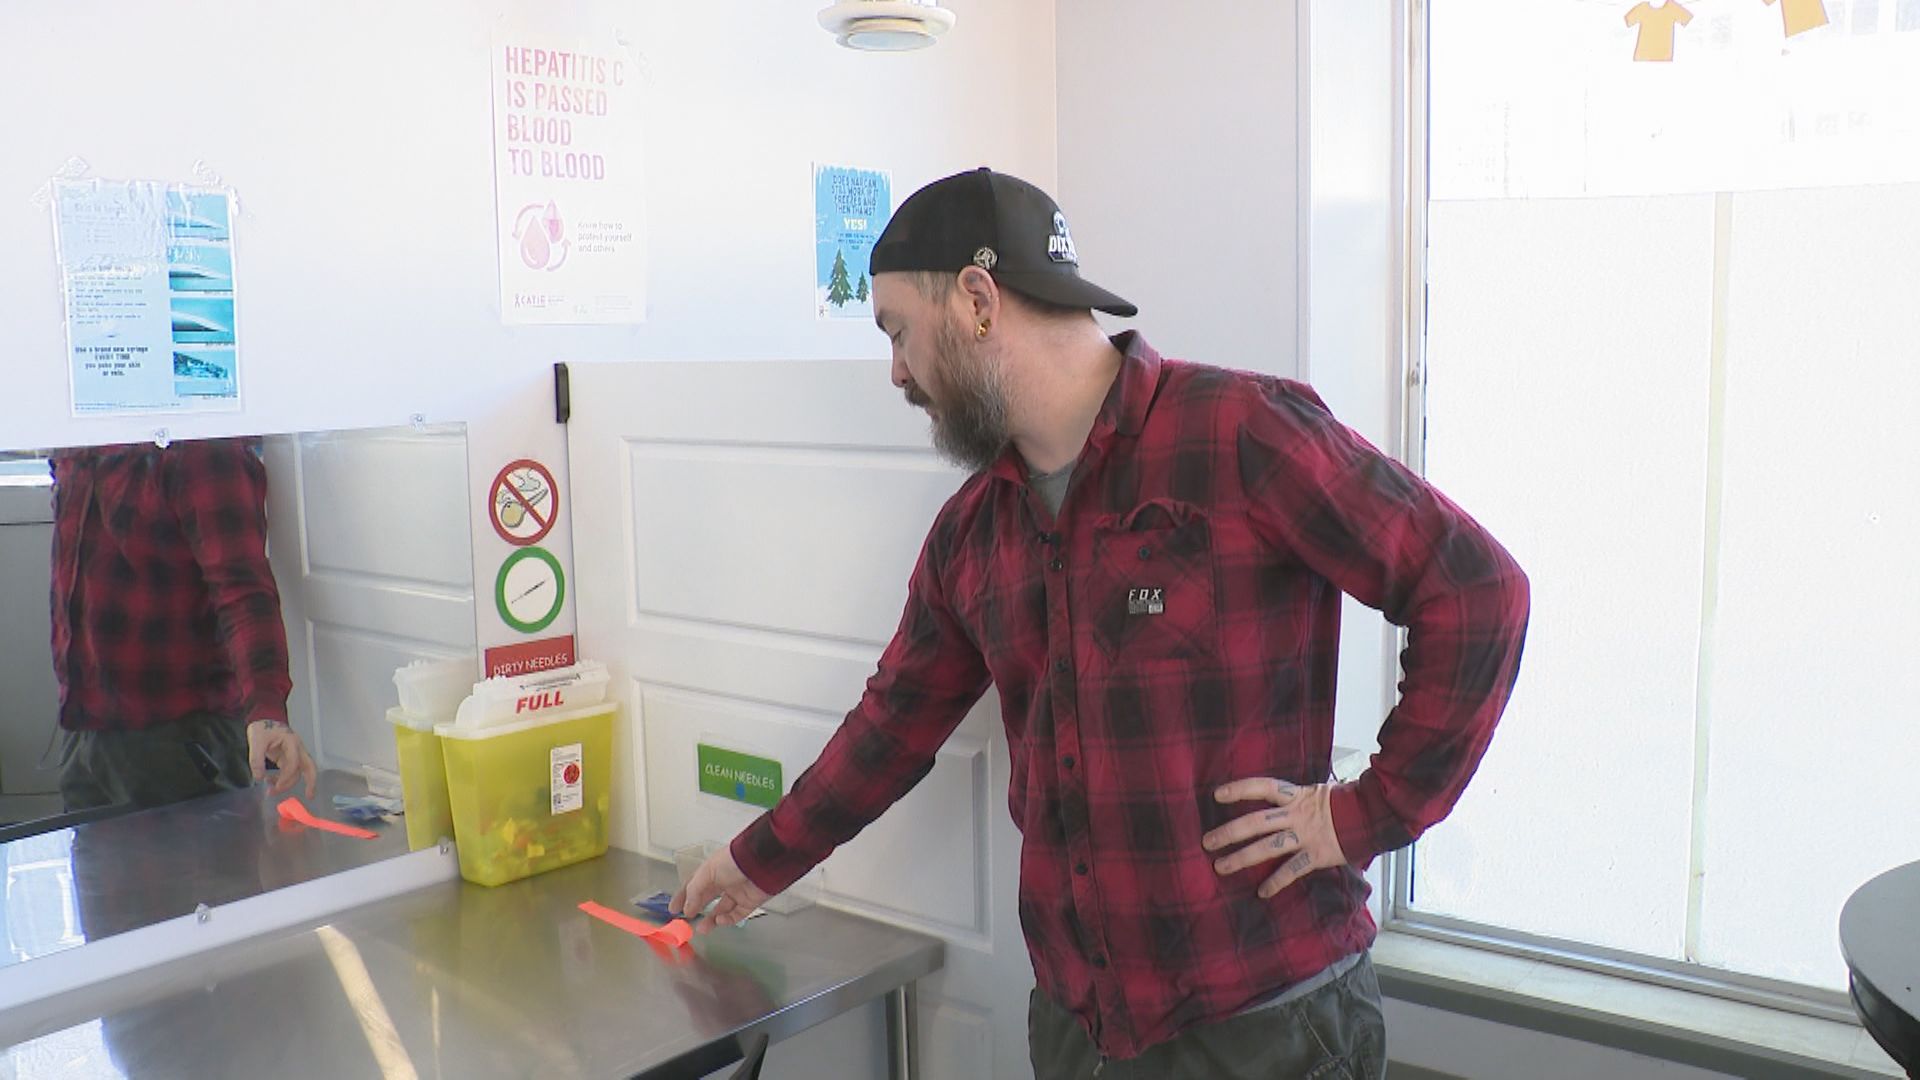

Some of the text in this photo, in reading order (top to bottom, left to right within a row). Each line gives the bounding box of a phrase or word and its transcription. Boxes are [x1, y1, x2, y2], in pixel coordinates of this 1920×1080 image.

[505, 45, 624, 86] HEPATITIS C
[506, 79, 608, 116] IS PASSED
[507, 113, 571, 146] BLOOD
[508, 148, 605, 180] TO BLOOD
[1128, 588, 1162, 601] FOX
[493, 653, 568, 675] DIRTY NEEDLES
[515, 691, 564, 714] FULL
[704, 763, 775, 790] CLEAN NEEDLES
